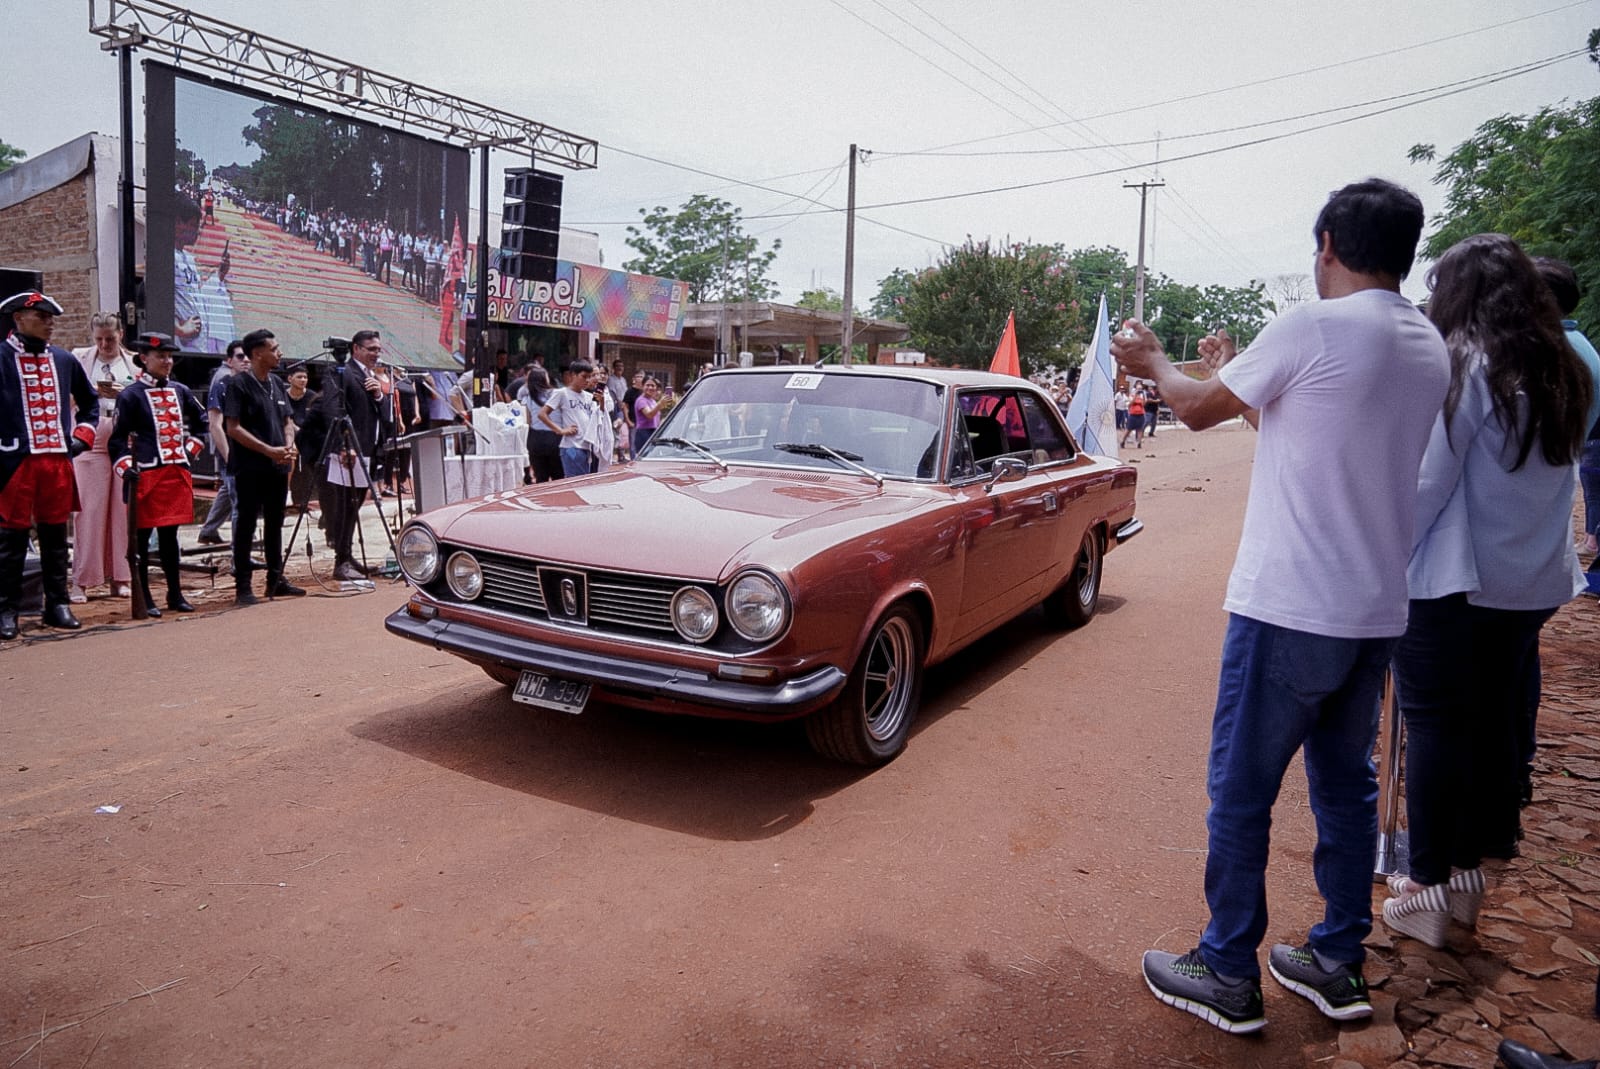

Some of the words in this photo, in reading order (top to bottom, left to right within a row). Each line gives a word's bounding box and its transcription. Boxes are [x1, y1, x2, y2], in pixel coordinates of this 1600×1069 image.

[503, 303, 515, 319] Y
[518, 304, 584, 327] LIBRERÍA
[517, 672, 549, 697] WWG
